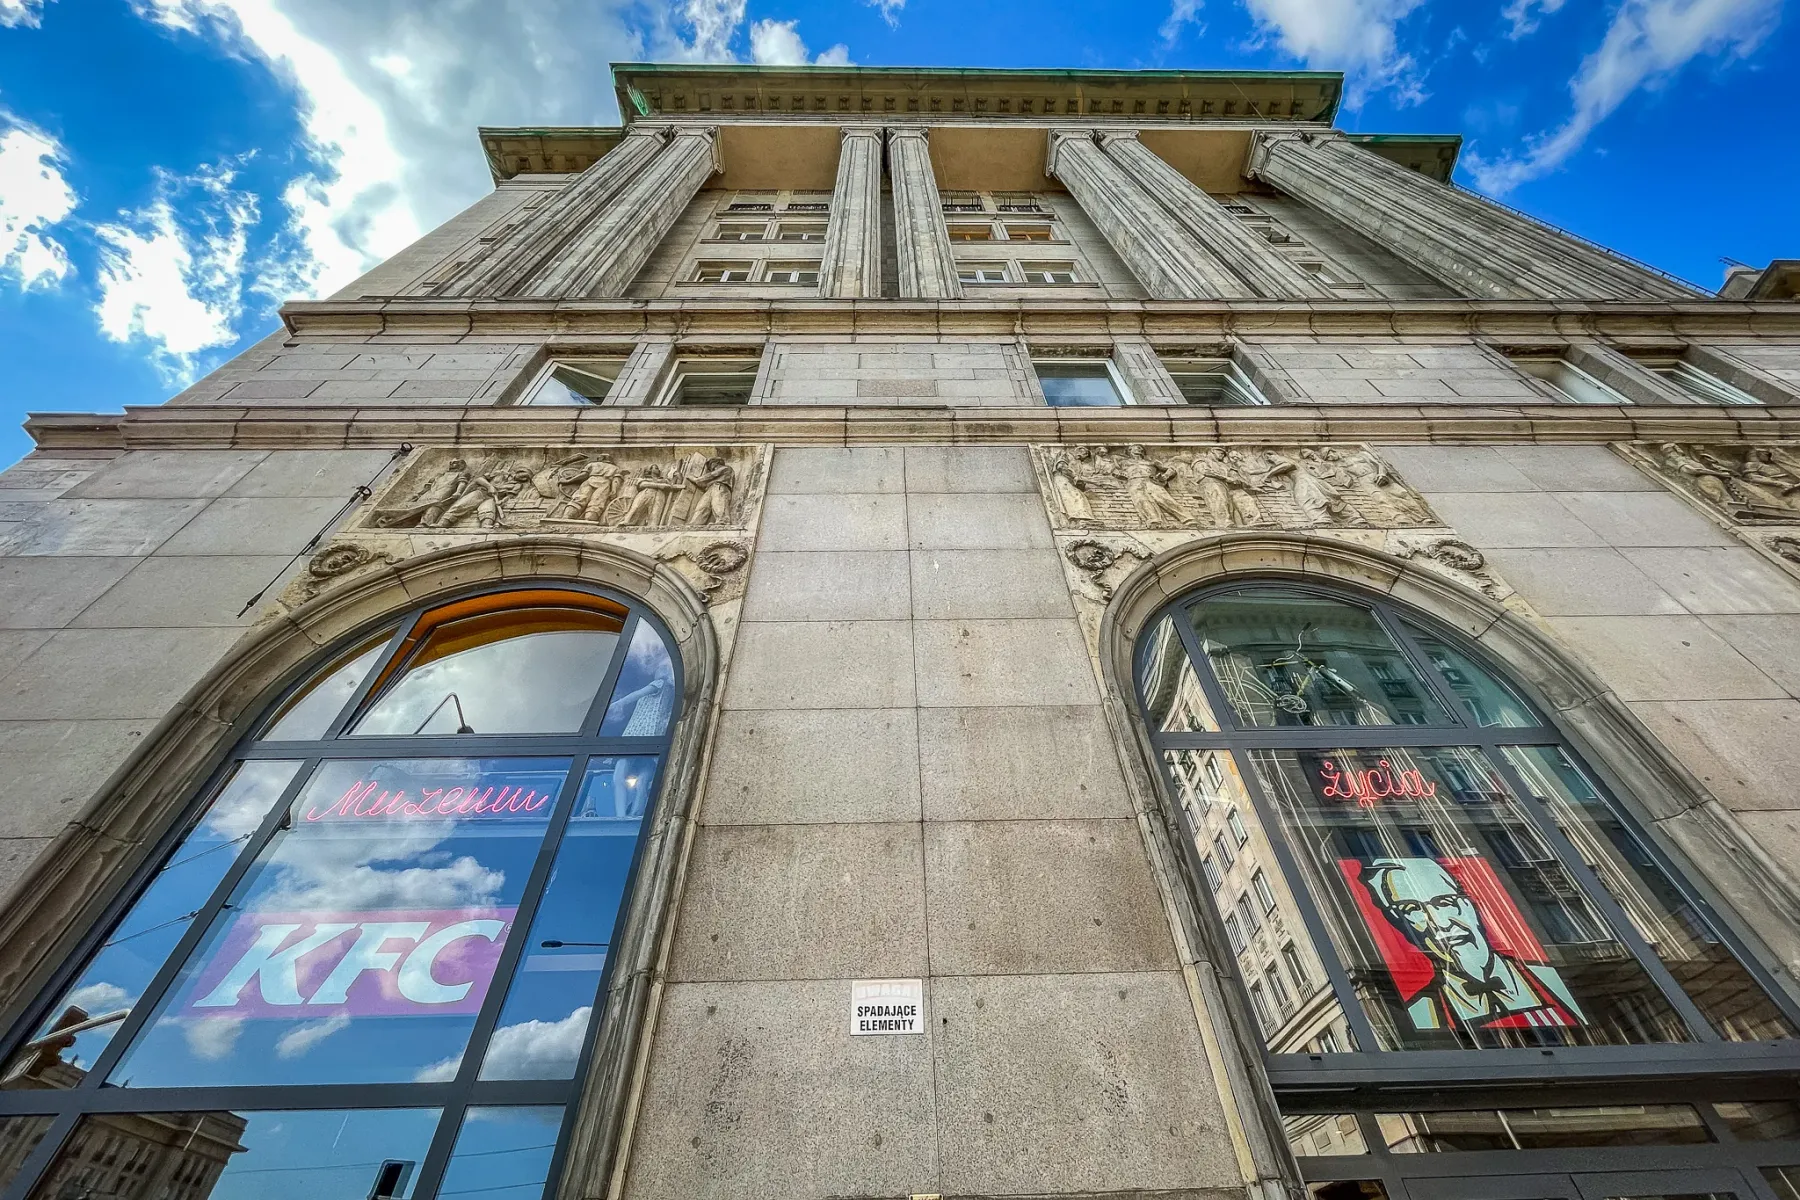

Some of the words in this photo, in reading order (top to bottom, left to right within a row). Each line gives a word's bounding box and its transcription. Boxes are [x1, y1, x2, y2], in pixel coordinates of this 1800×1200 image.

[306, 780, 549, 821] Muzeum
[1320, 760, 1435, 808] życia
[192, 919, 506, 1007] KFC
[857, 1005, 917, 1019] SPADAJĄCE
[860, 1019, 914, 1031] ELEMENTY
